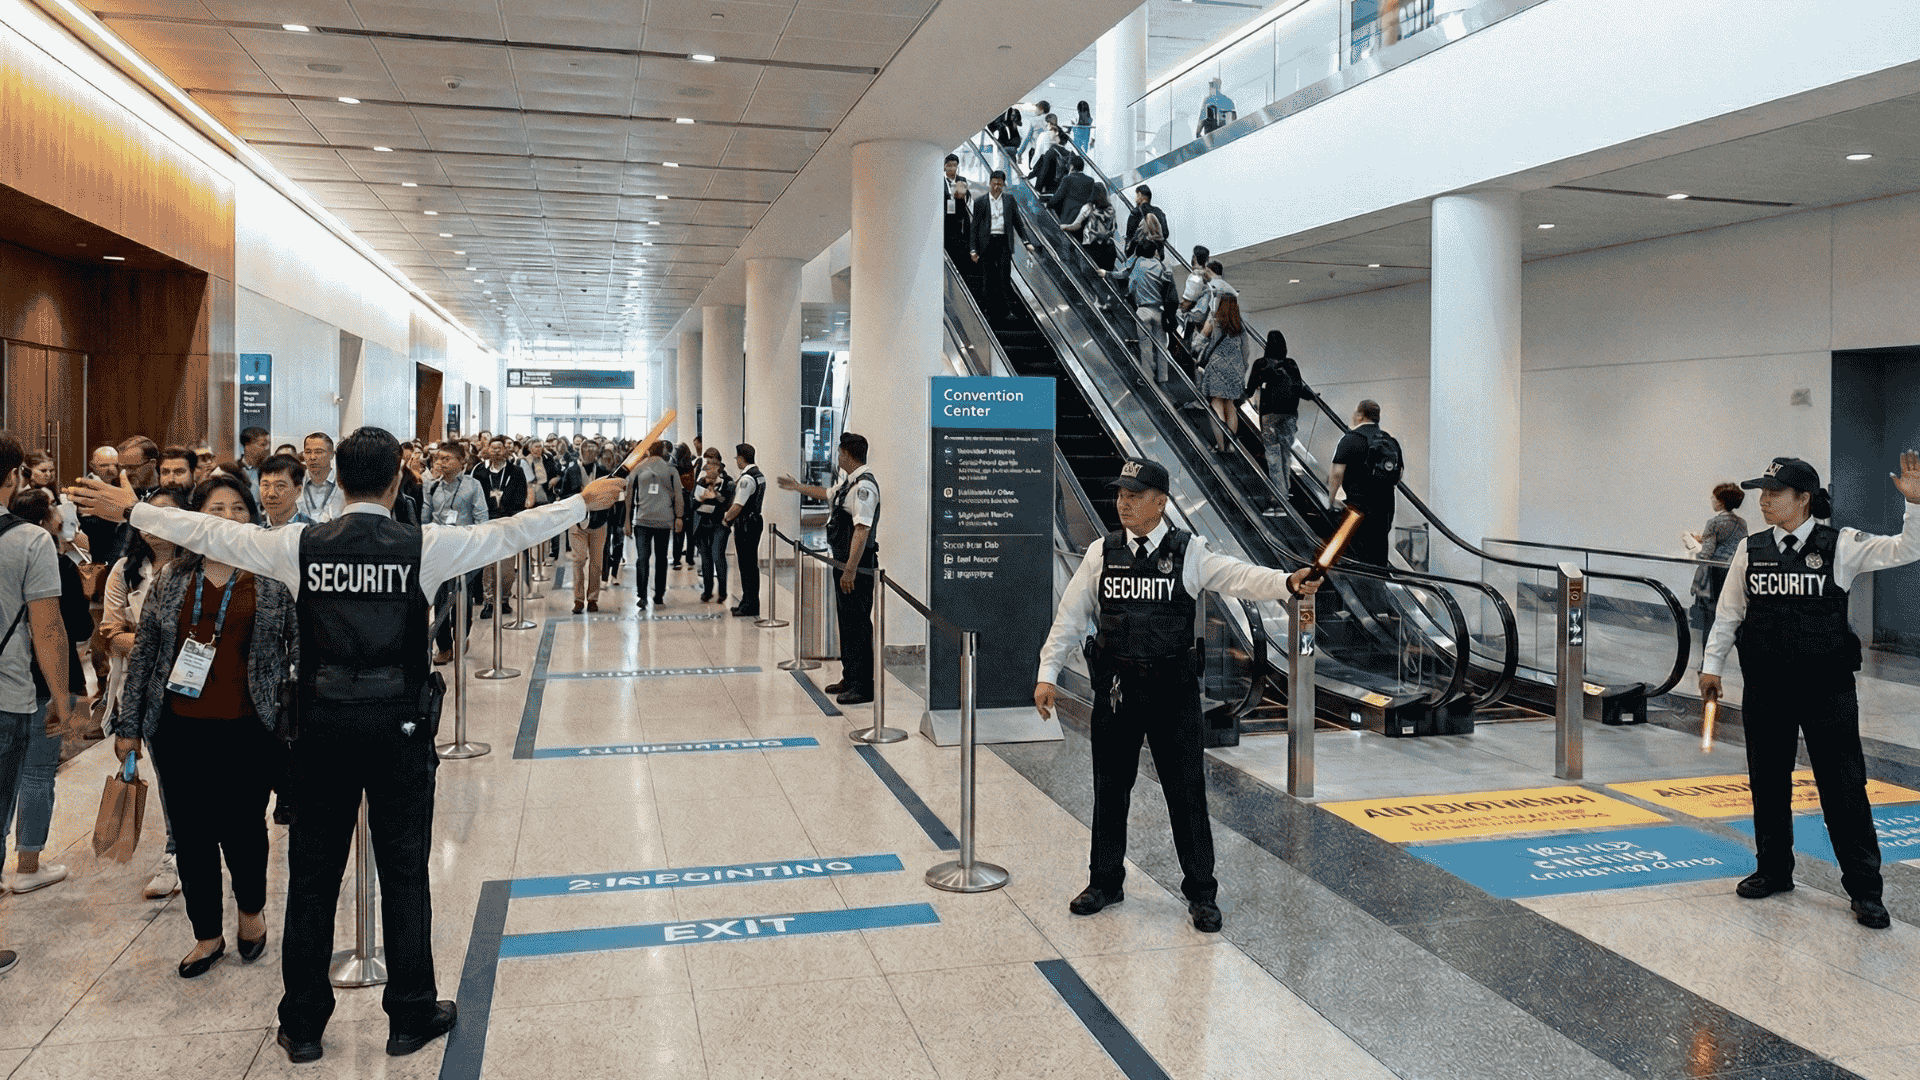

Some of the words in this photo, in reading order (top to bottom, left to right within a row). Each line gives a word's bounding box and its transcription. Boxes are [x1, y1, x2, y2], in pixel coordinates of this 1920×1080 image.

[944, 389, 1024, 402] Convention
[944, 405, 991, 417] Center
[307, 563, 412, 593] SECURITY
[1103, 577, 1175, 601] SECURITY
[1750, 573, 1826, 597] SECURITY
[664, 917, 796, 942] EXIT
